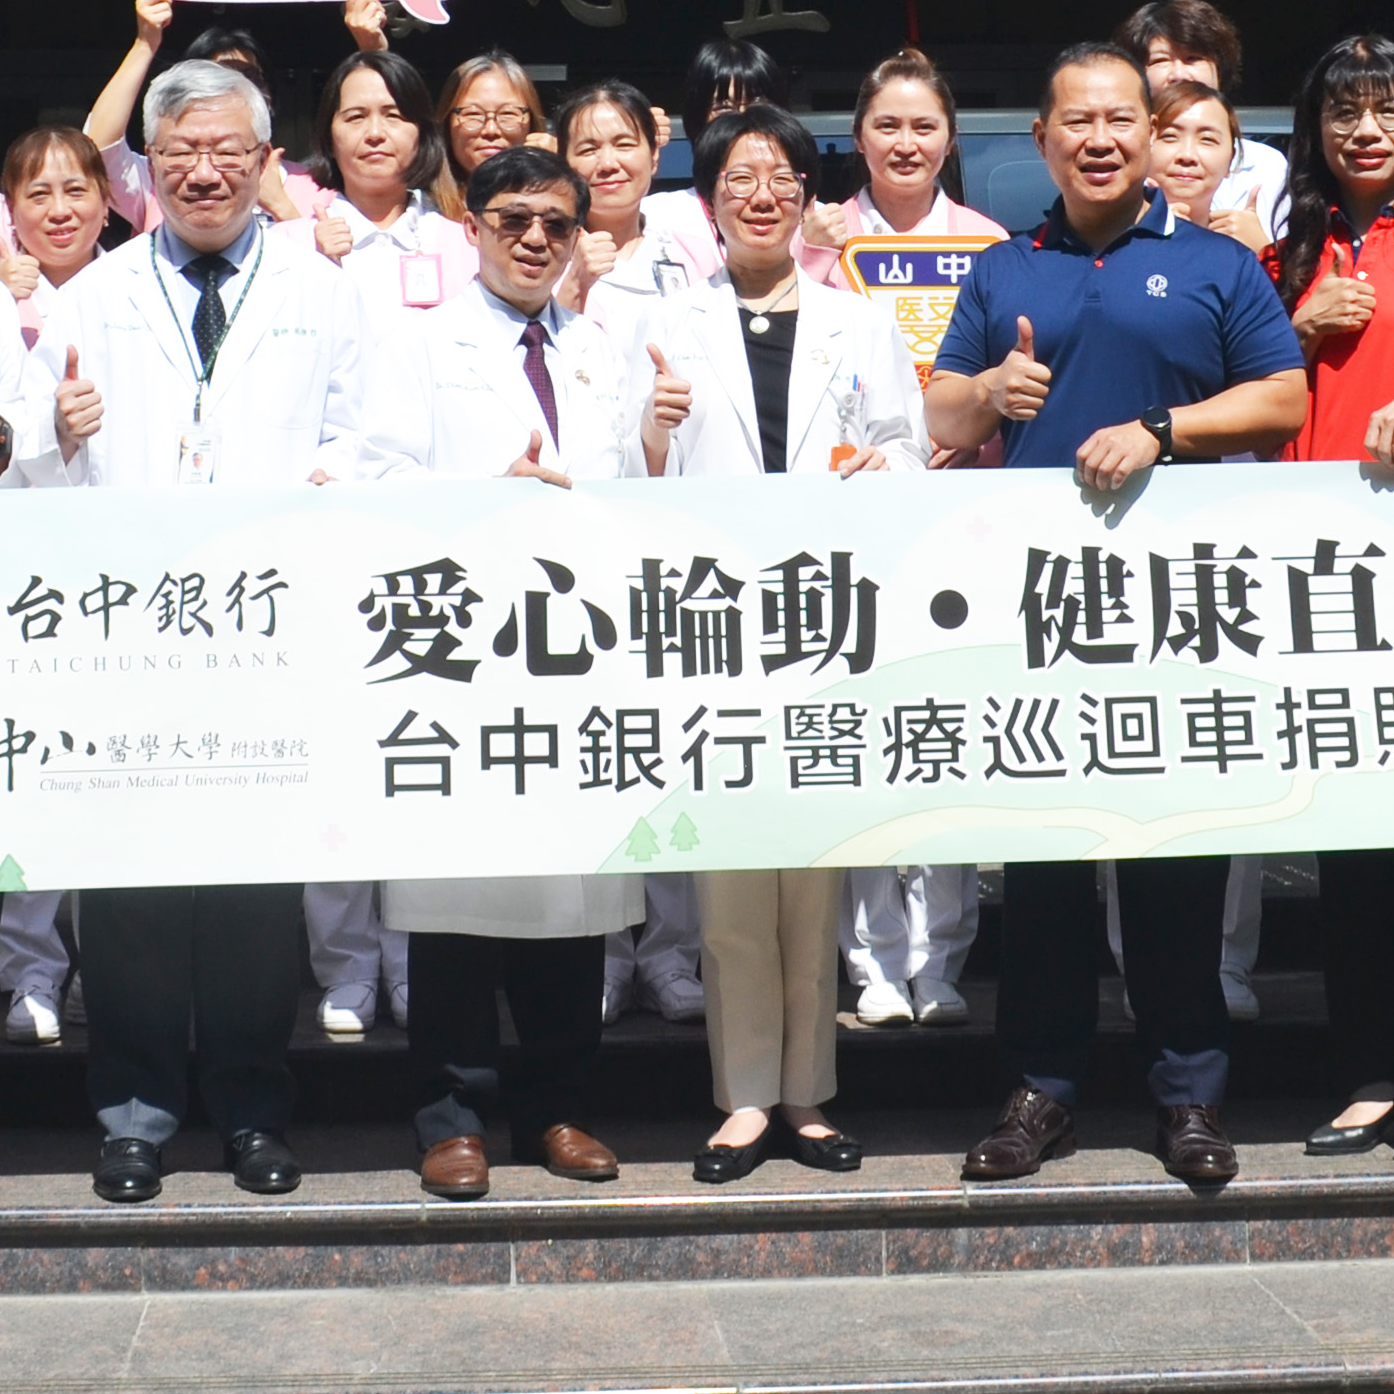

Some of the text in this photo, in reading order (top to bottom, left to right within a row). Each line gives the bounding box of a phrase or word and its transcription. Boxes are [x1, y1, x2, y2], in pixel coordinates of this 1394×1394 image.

[6, 567, 290, 643] 台中銀行
[6, 651, 290, 674] TAICHUNG BANK
[39, 770, 309, 794] Chung Shan Medical University Hospital
